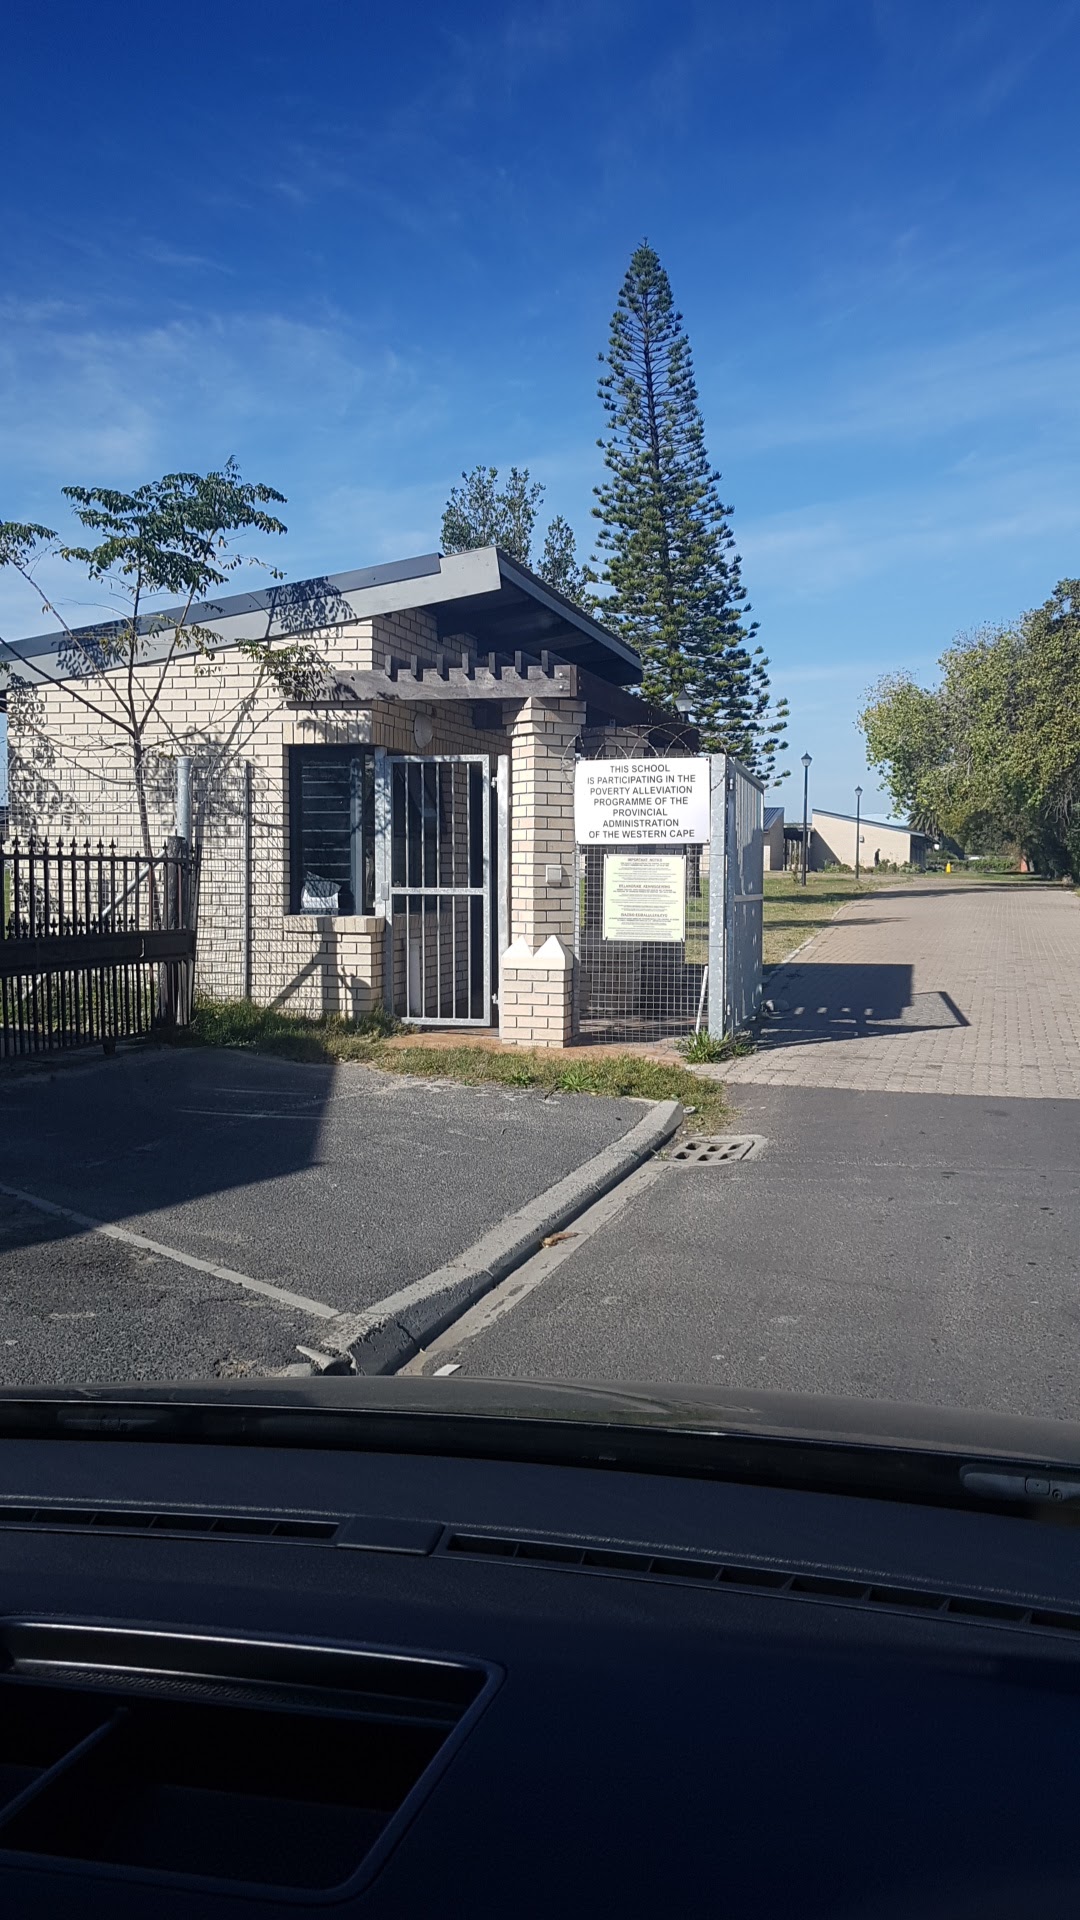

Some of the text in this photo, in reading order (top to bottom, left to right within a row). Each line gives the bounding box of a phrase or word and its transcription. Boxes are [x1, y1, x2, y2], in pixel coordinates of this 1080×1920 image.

[610, 764, 670, 773] THIS SCHOOL
[587, 774, 696, 784] IS PARTICIPATING IN THE
[590, 785, 693, 795] POVERTY ALLEVIATION
[594, 797, 689, 806] PROGRAMME OF THE
[613, 808, 668, 817] PROVINCIAL
[603, 819, 679, 828] ADMINISTRATION
[588, 829, 695, 839] OF THE WESTERN CAPE
